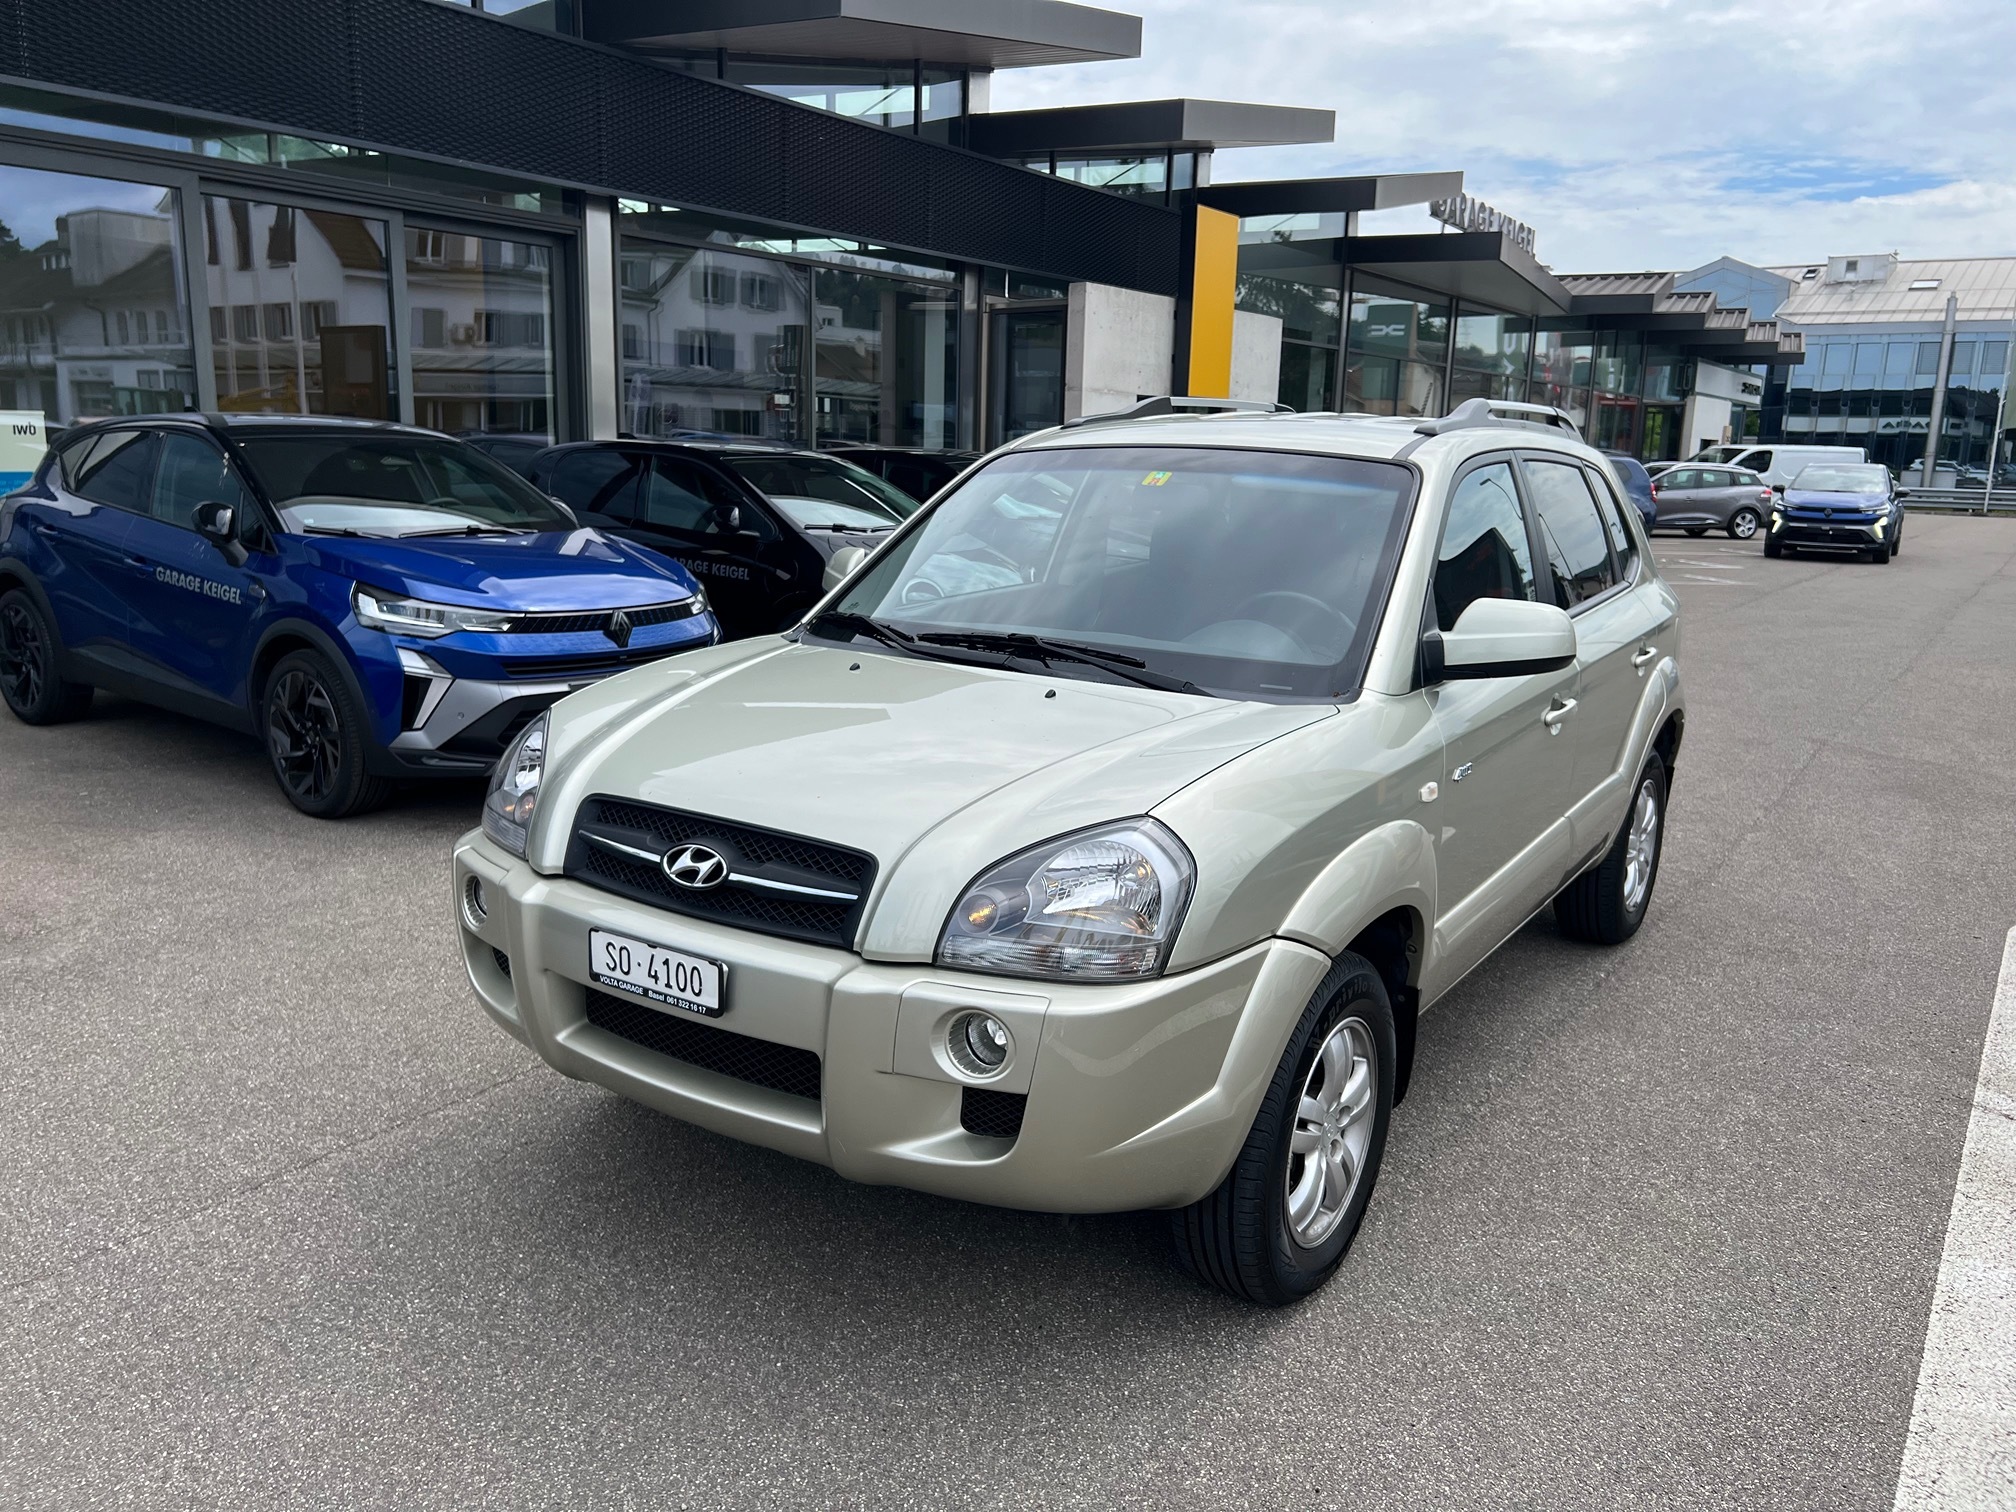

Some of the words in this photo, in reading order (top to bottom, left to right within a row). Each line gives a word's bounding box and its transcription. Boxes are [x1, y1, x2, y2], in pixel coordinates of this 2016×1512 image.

[156, 566, 201, 592] GARAGE
[203, 580, 242, 605] KEIGEL
[711, 563, 750, 580] KEIGEL
[600, 975, 618, 988] VOLTA
[619, 981, 644, 995] GARAGE
[648, 990, 665, 1002] Basel
[666, 995, 678, 1006] 061
[678, 998, 690, 1009] 322
[699, 1005, 707, 1015] 17
